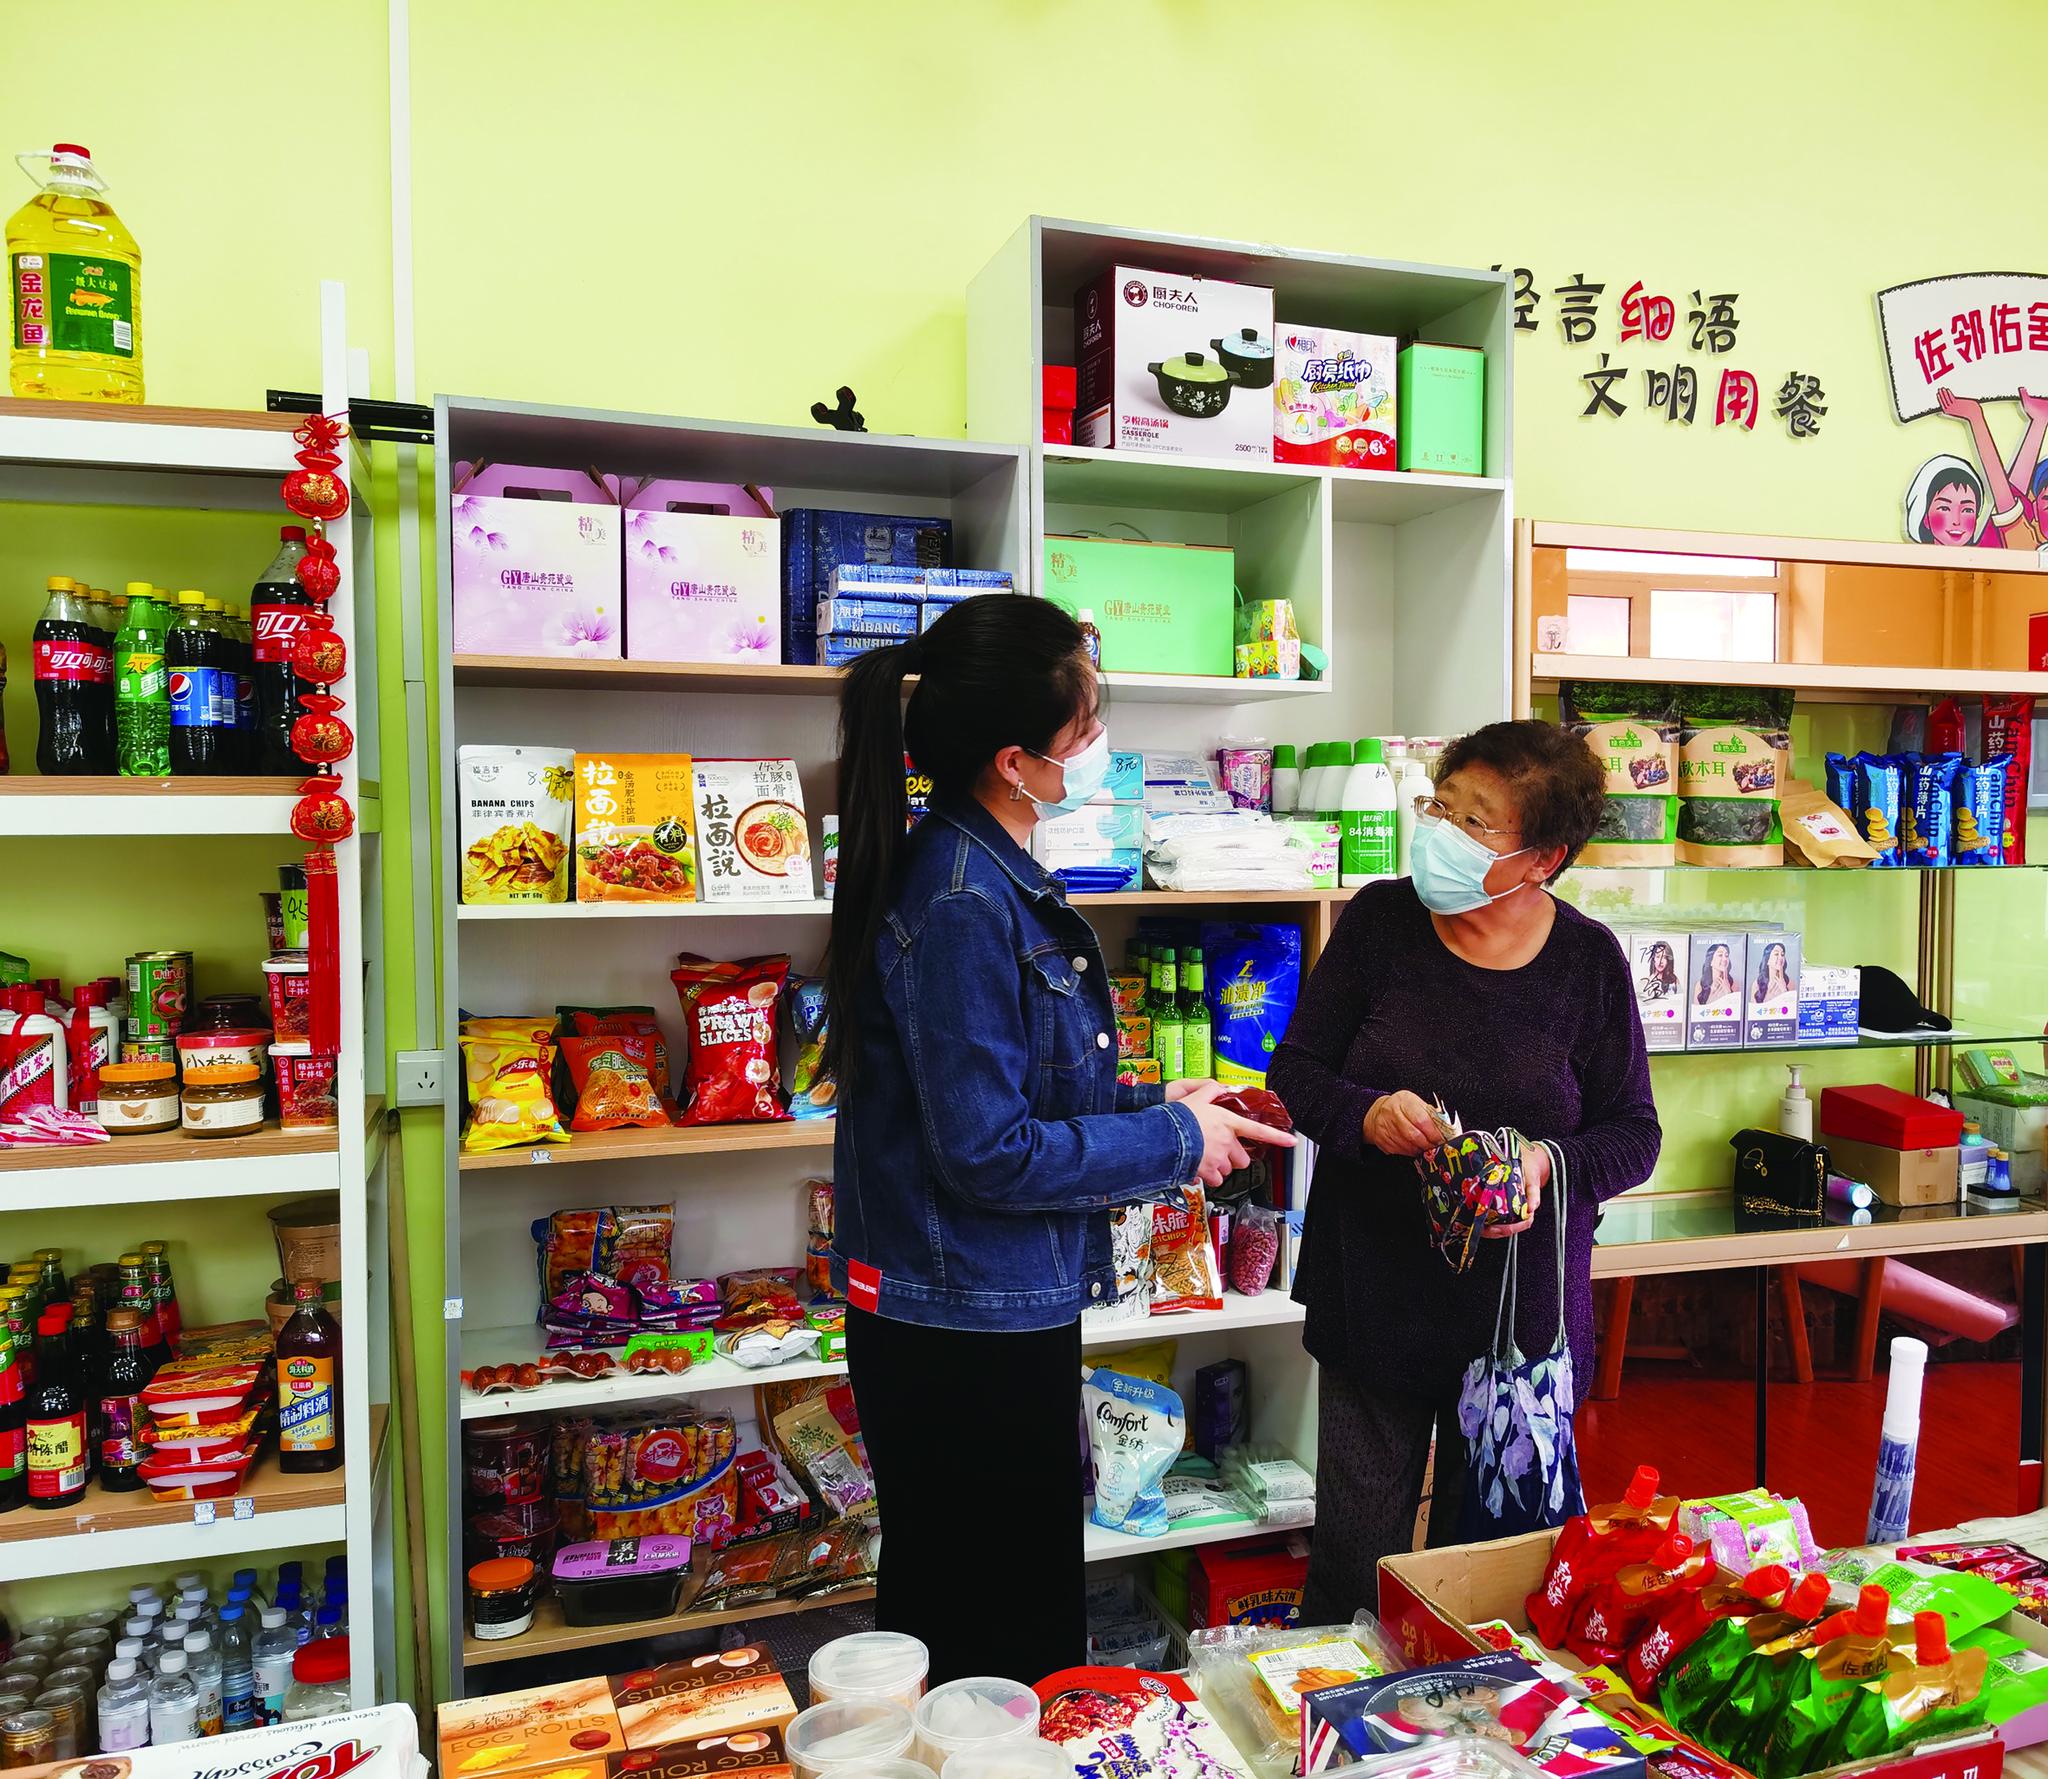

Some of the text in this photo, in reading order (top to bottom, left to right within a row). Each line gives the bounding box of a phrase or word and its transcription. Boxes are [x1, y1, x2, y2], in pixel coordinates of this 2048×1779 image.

[1153, 286, 1198, 305] 厨夫人
[20, 271, 44, 345] 金龙鱼
[1153, 300, 1199, 313] CHOFOREN
[1302, 359, 1372, 383] 厨房纸巾
[1579, 352, 1828, 438] 文明用餐
[501, 569, 522, 585] GY
[671, 581, 690, 597] GY
[852, 620, 901, 634] LIBANG
[1916, 765, 1933, 819] 山药薄片
[1976, 765, 1990, 819] 山药薄片
[1349, 826, 1394, 837] 84消毒液
[1220, 981, 1267, 1005] 油渍净
[699, 1012, 765, 1032] PRAWN
[700, 1028, 753, 1046] SLICES
[1112, 1377, 1155, 1399] 全新升级
[1096, 1401, 1149, 1436] Comfort
[627, 1663, 770, 1703] EGG ROLLS
[265, 1721, 317, 1737] delicious
[320, 1714, 350, 1726] more
[451, 1715, 607, 1753] EGG ROLLS
[717, 1751, 779, 1768] EGG
